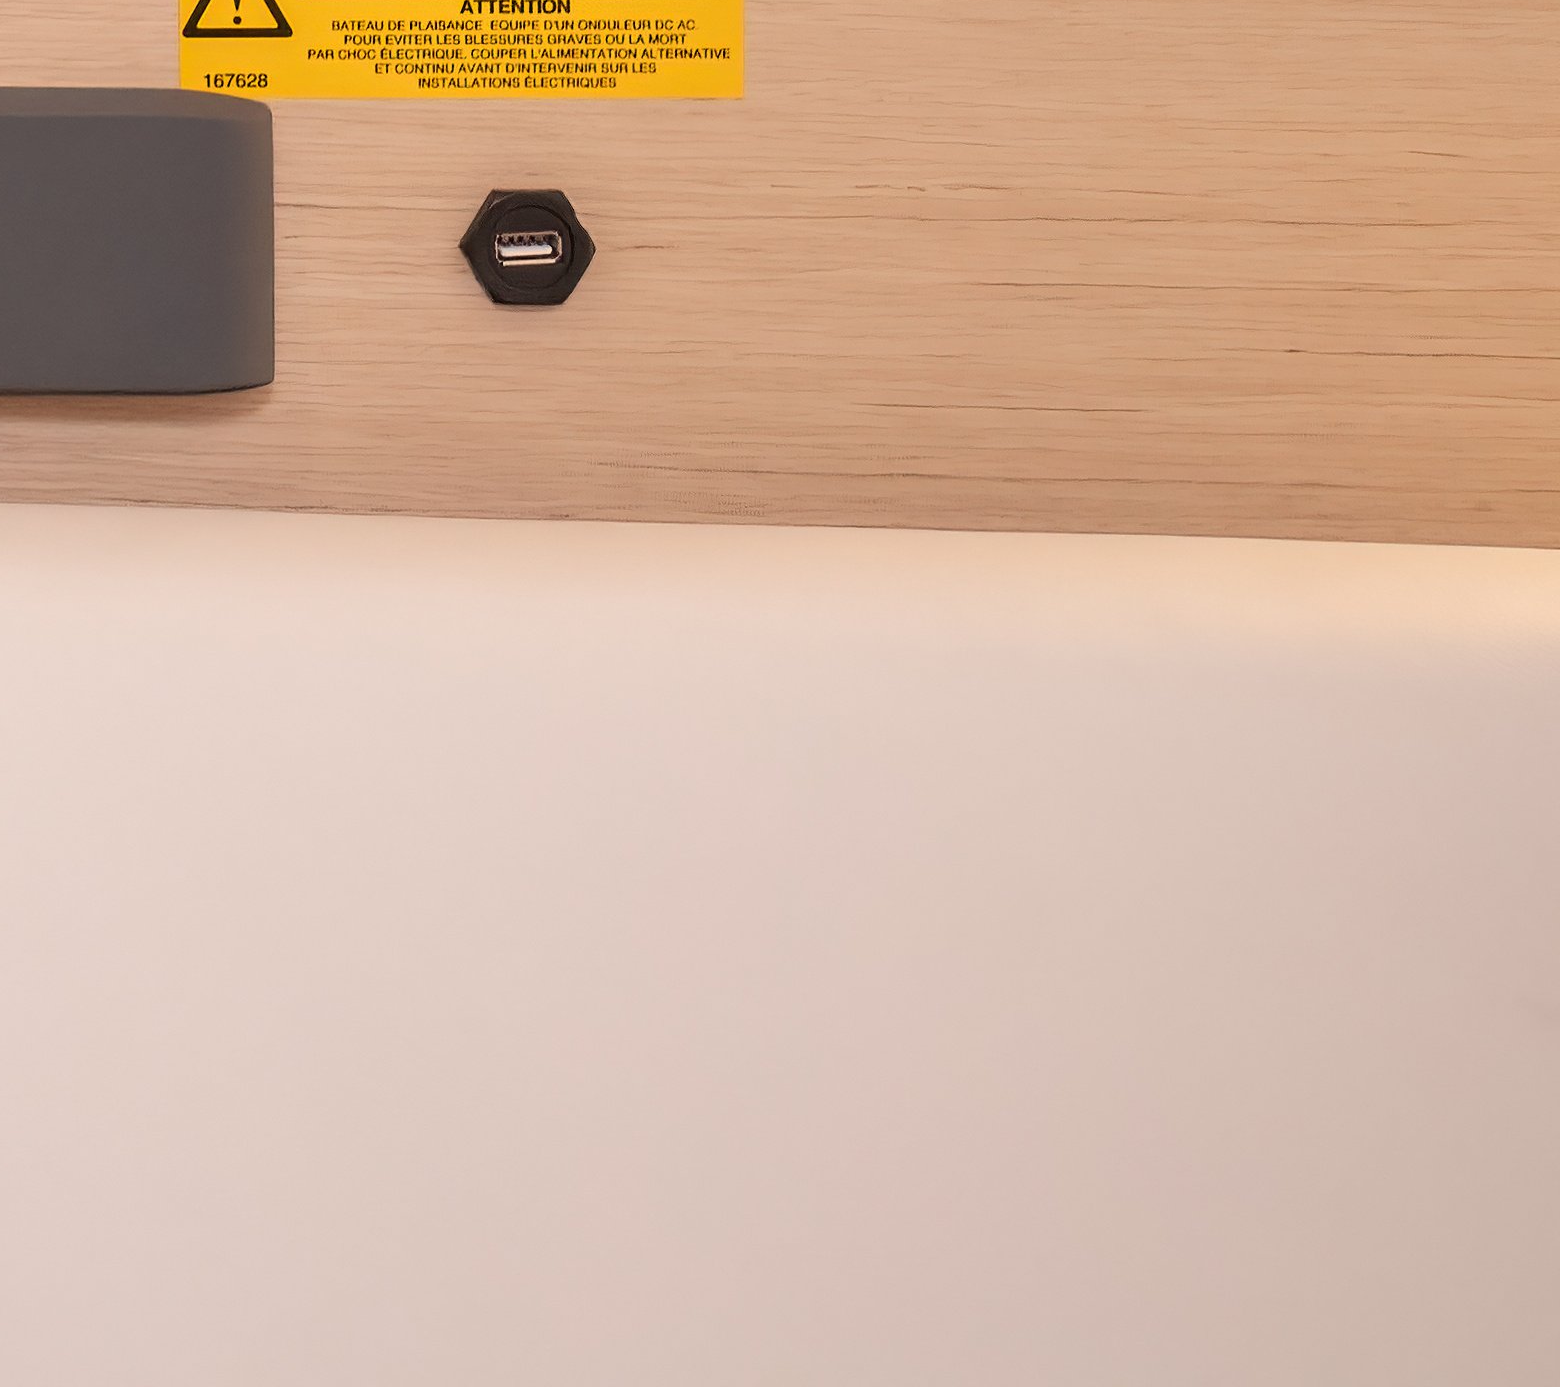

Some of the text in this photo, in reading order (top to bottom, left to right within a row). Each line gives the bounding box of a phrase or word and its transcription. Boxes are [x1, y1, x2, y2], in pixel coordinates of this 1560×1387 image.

[460, 0, 570, 14] ATTENTION
[332, 20, 383, 31] BATEAU
[388, 20, 405, 31] DE
[410, 20, 482, 31] PLAISANCE
[544, 20, 574, 30] D'UN
[578, 19, 651, 31] ONDULEUR
[655, 19, 673, 31] DC
[677, 19, 695, 30] AC
[344, 33, 686, 46] POUR EVITER LES BLESSURES GRAVES OU LA MORT
[308, 47, 730, 60] PAR CHOC ÉLECTRIQUE. COUPER L'ALIMENTATION ALTERNATIVE
[375, 62, 656, 74] ET CONTINU AVANT D'INTERVENIR SUR LES
[205, 74, 267, 88] 167628
[418, 75, 616, 88] INSTALLATIONS ÉLECTRIQUES
